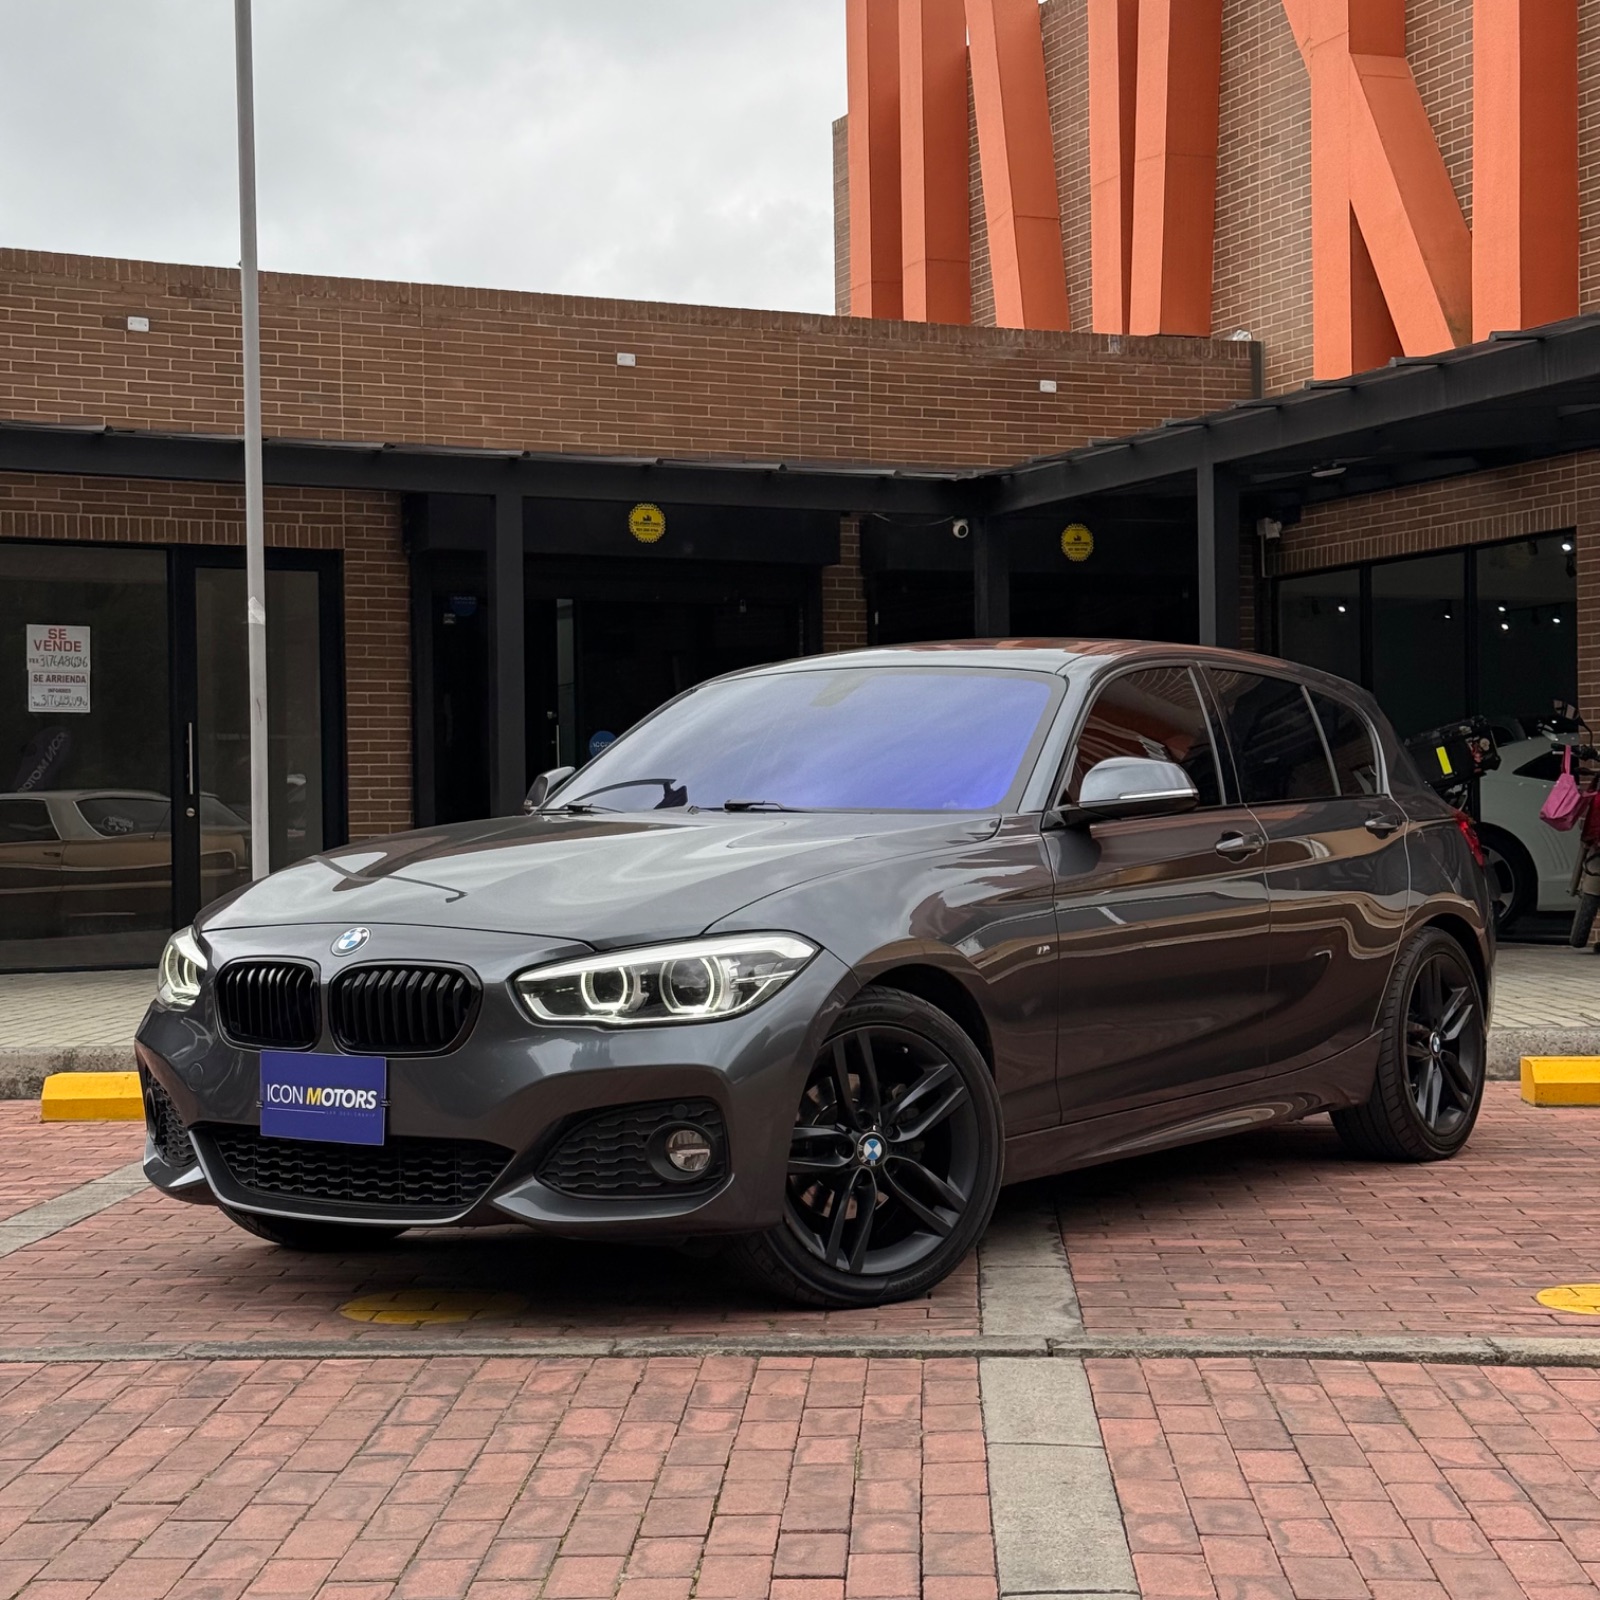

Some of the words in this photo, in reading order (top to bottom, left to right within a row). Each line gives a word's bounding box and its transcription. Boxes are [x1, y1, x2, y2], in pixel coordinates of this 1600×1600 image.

[48, 628, 67, 640] SE
[33, 640, 82, 652] VENDE
[33, 674, 44, 683] SE
[45, 674, 87, 684] ARRIENDA
[267, 1083, 303, 1105] ICON
[306, 1087, 378, 1110] MOTORS
